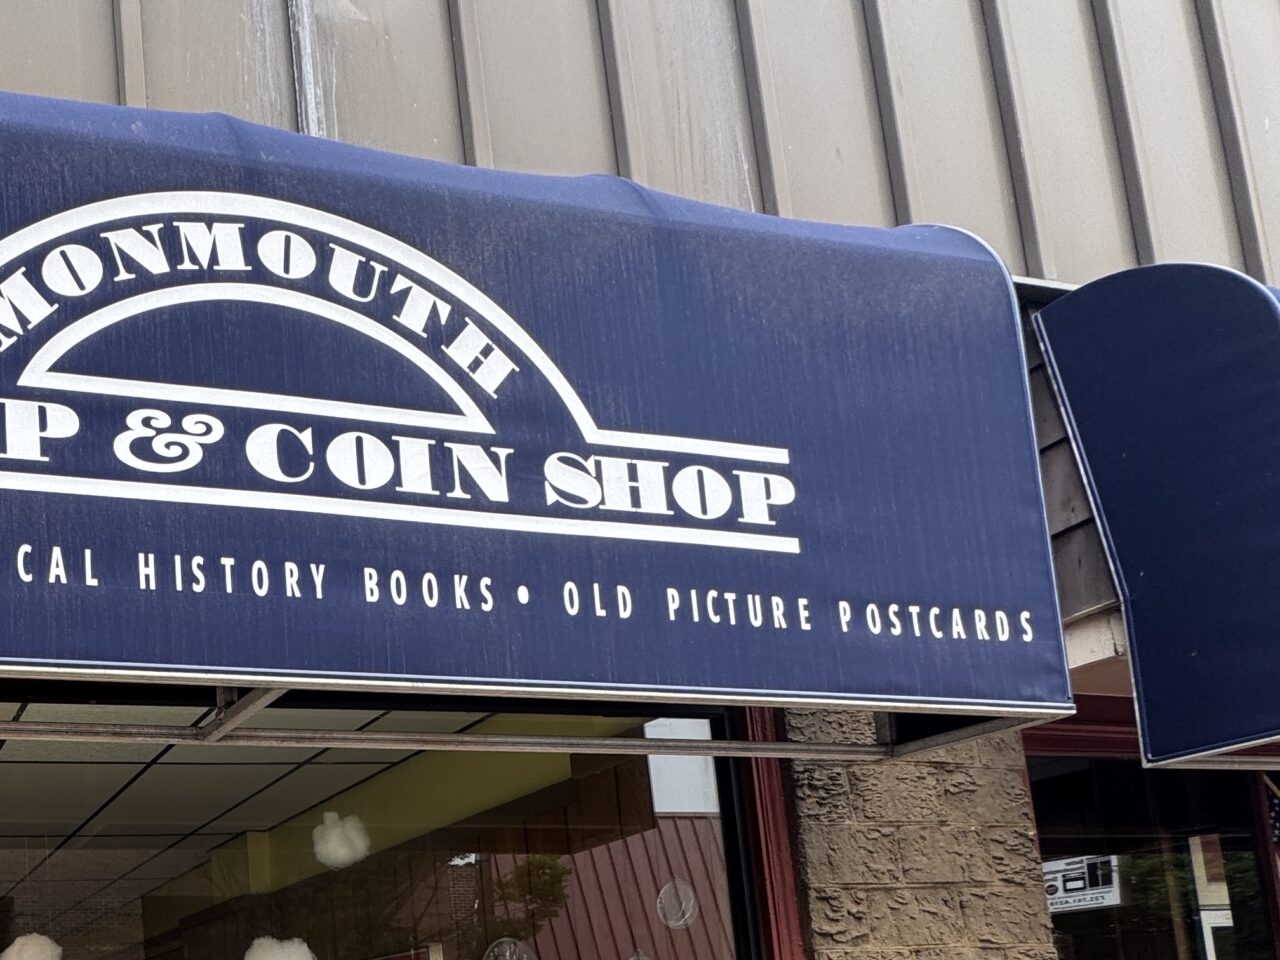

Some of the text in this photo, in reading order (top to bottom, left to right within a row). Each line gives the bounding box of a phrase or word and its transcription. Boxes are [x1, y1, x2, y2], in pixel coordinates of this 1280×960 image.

[112, 408, 225, 473] &
[245, 423, 515, 503] COIN
[543, 451, 796, 526] SHOP
[138, 552, 326, 600] HISTORY
[363, 567, 494, 612] BOOKS
[563, 581, 632, 619] OLD
[666, 587, 812, 631] PICTURE
[838, 600, 1034, 643] POSTCARDS
